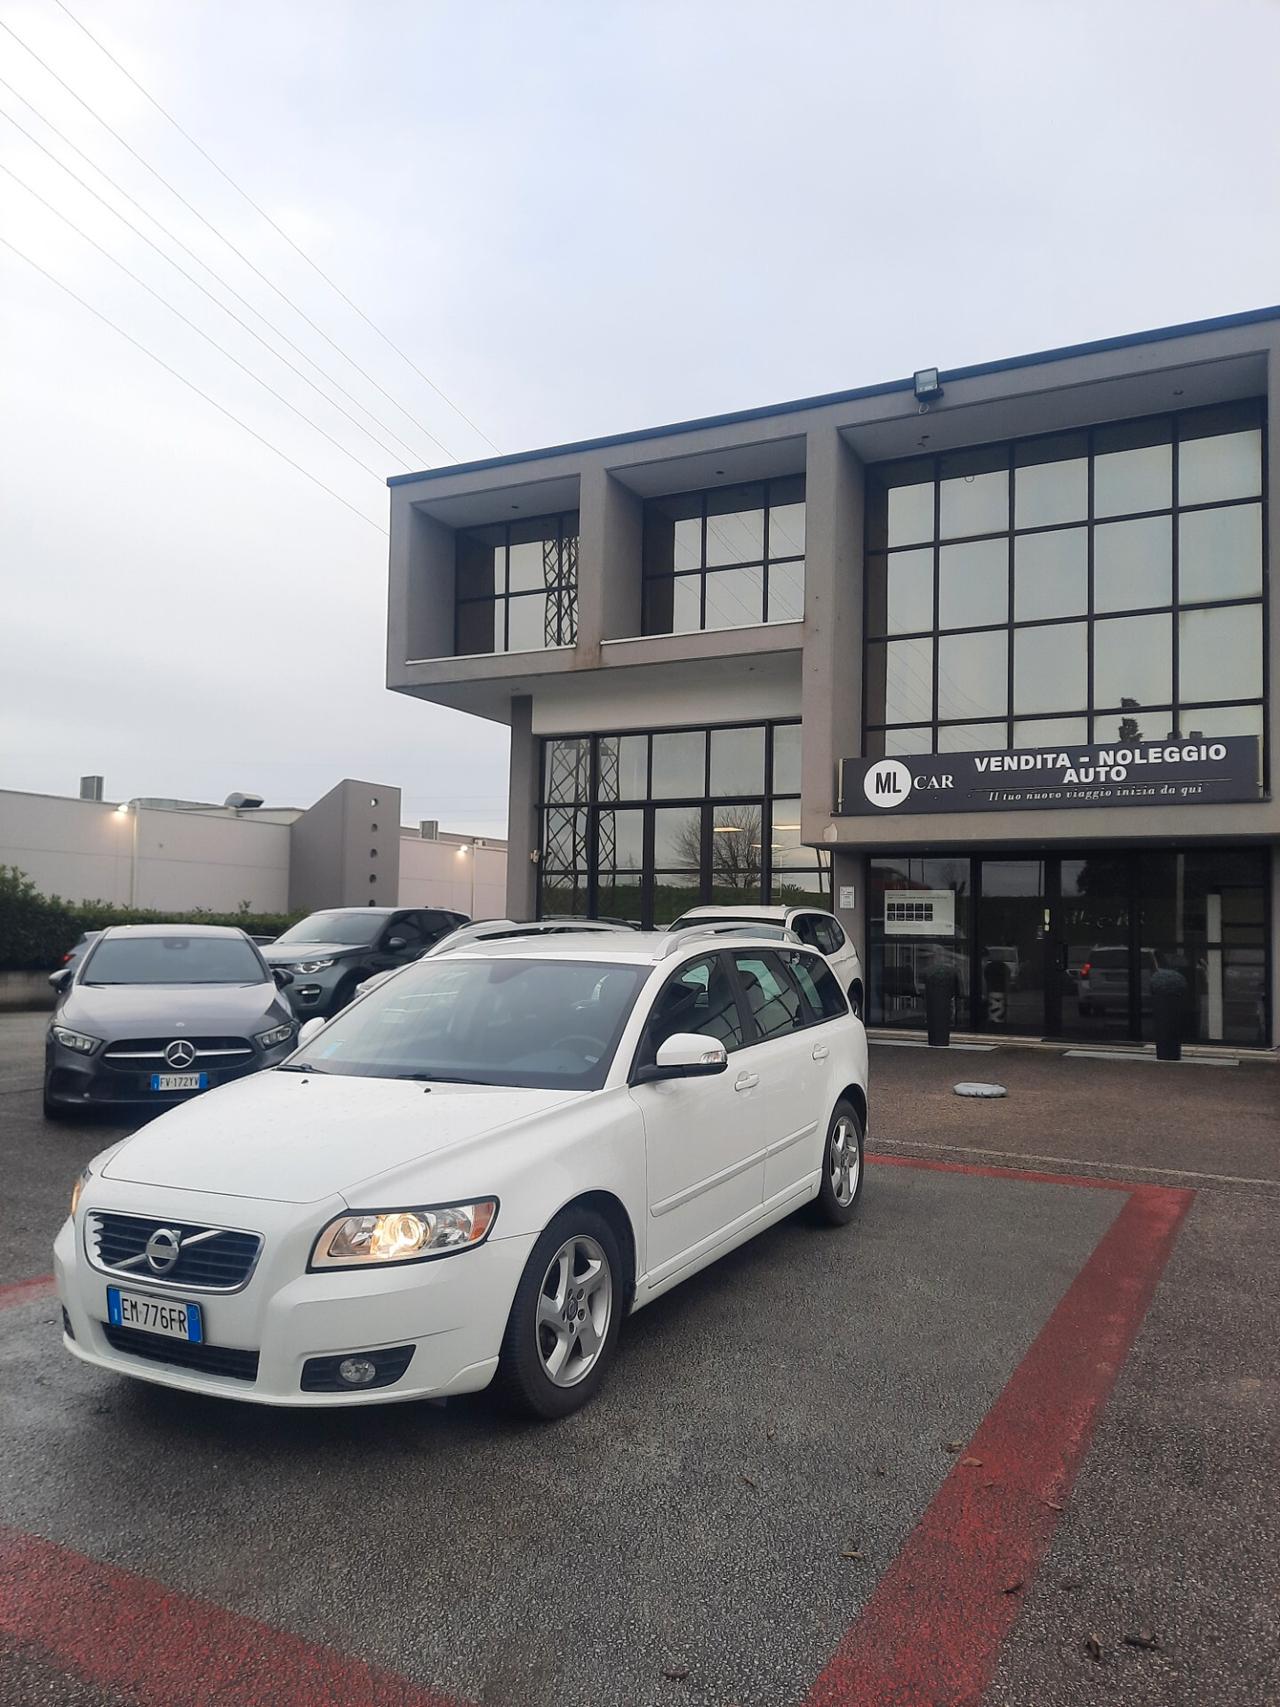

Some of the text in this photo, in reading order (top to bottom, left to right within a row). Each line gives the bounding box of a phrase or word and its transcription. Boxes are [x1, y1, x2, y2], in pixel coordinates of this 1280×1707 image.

[974, 753, 1072, 772] VENDITA
[1098, 744, 1227, 766] NOLEGGIO
[875, 771, 954, 794] ML CAR
[1062, 766, 1127, 783] AUTO
[988, 783, 1203, 801] Il tuo nuovo viaggio inizia da qui
